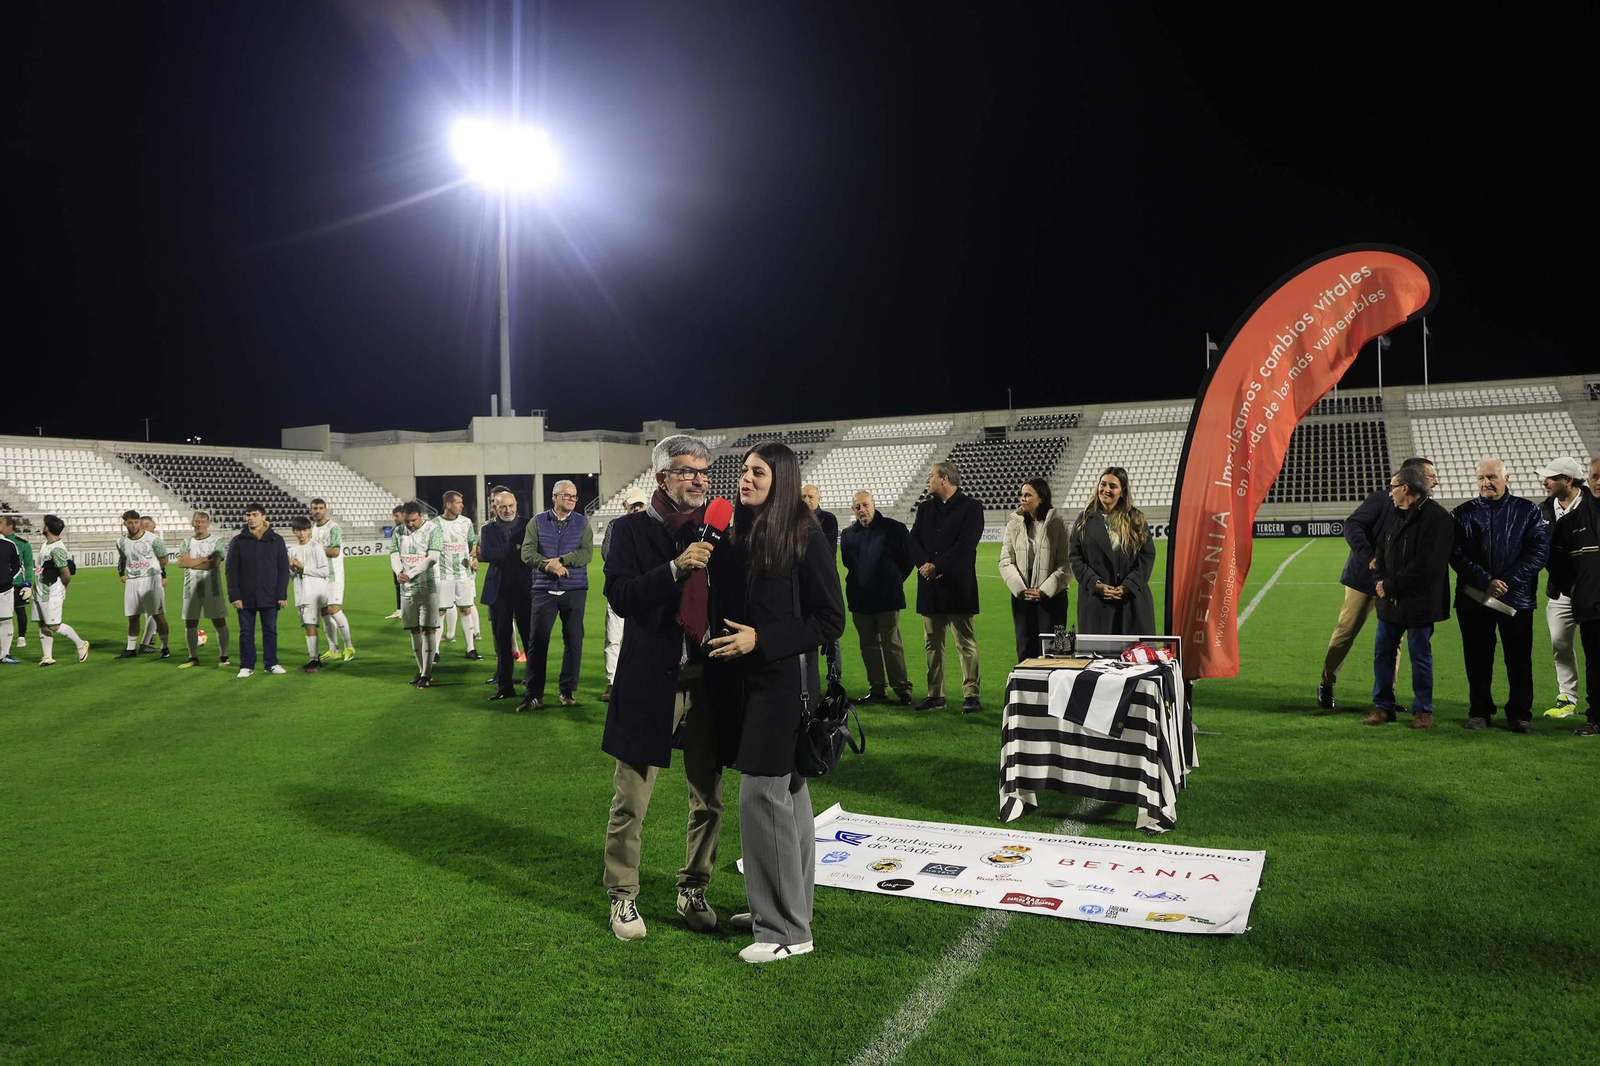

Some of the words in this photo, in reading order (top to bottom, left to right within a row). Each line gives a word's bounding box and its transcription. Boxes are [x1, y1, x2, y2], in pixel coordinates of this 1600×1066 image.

[1260, 311, 1315, 378] cambios
[1314, 265, 1372, 312] vitales
[1236, 479, 1249, 497] en
[1262, 402, 1279, 420] de
[1273, 380, 1290, 401] los
[1288, 351, 1314, 380] más
[1313, 288, 1386, 352] vulnerables
[1257, 523, 1285, 532] TERCERA
[84, 552, 114, 566] UBAGO
[1193, 511, 1231, 644] BETANIA
[876, 834, 963, 850] Diputación
[963, 829, 1036, 840] SOLIDARIO
[1039, 837, 1110, 848] EDUARDO
[1113, 844, 1158, 852] MENA
[1162, 849, 1250, 862] GUERRERO
[929, 864, 960, 873] AC
[1058, 858, 1220, 882] BETANIA
[932, 884, 985, 896] LOBBY
